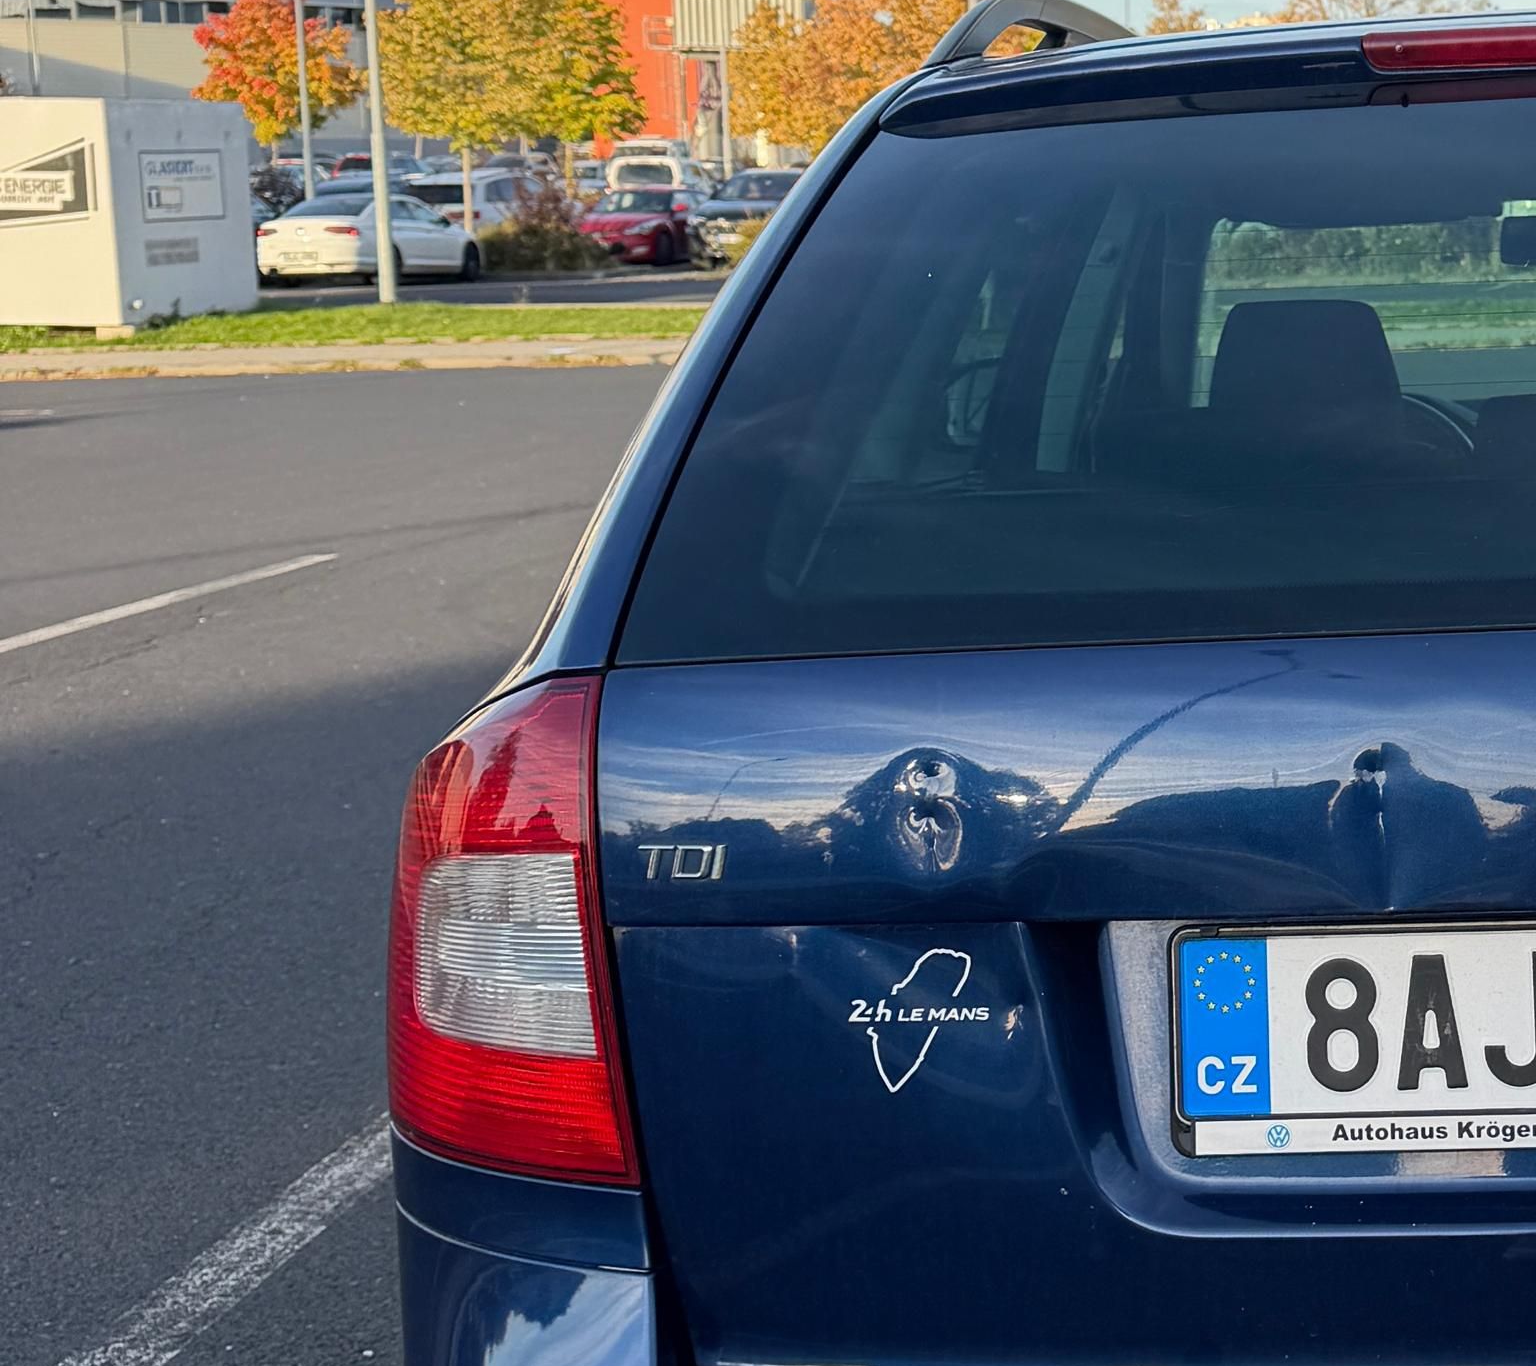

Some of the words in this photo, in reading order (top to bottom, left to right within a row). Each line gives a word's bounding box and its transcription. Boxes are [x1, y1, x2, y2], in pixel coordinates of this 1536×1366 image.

[637, 844, 728, 881] TDI
[898, 1008, 924, 1022] LE
[928, 1007, 990, 1021] MANS
[1197, 1056, 1257, 1095] CZ
[1332, 1123, 1448, 1142] Autohaus
